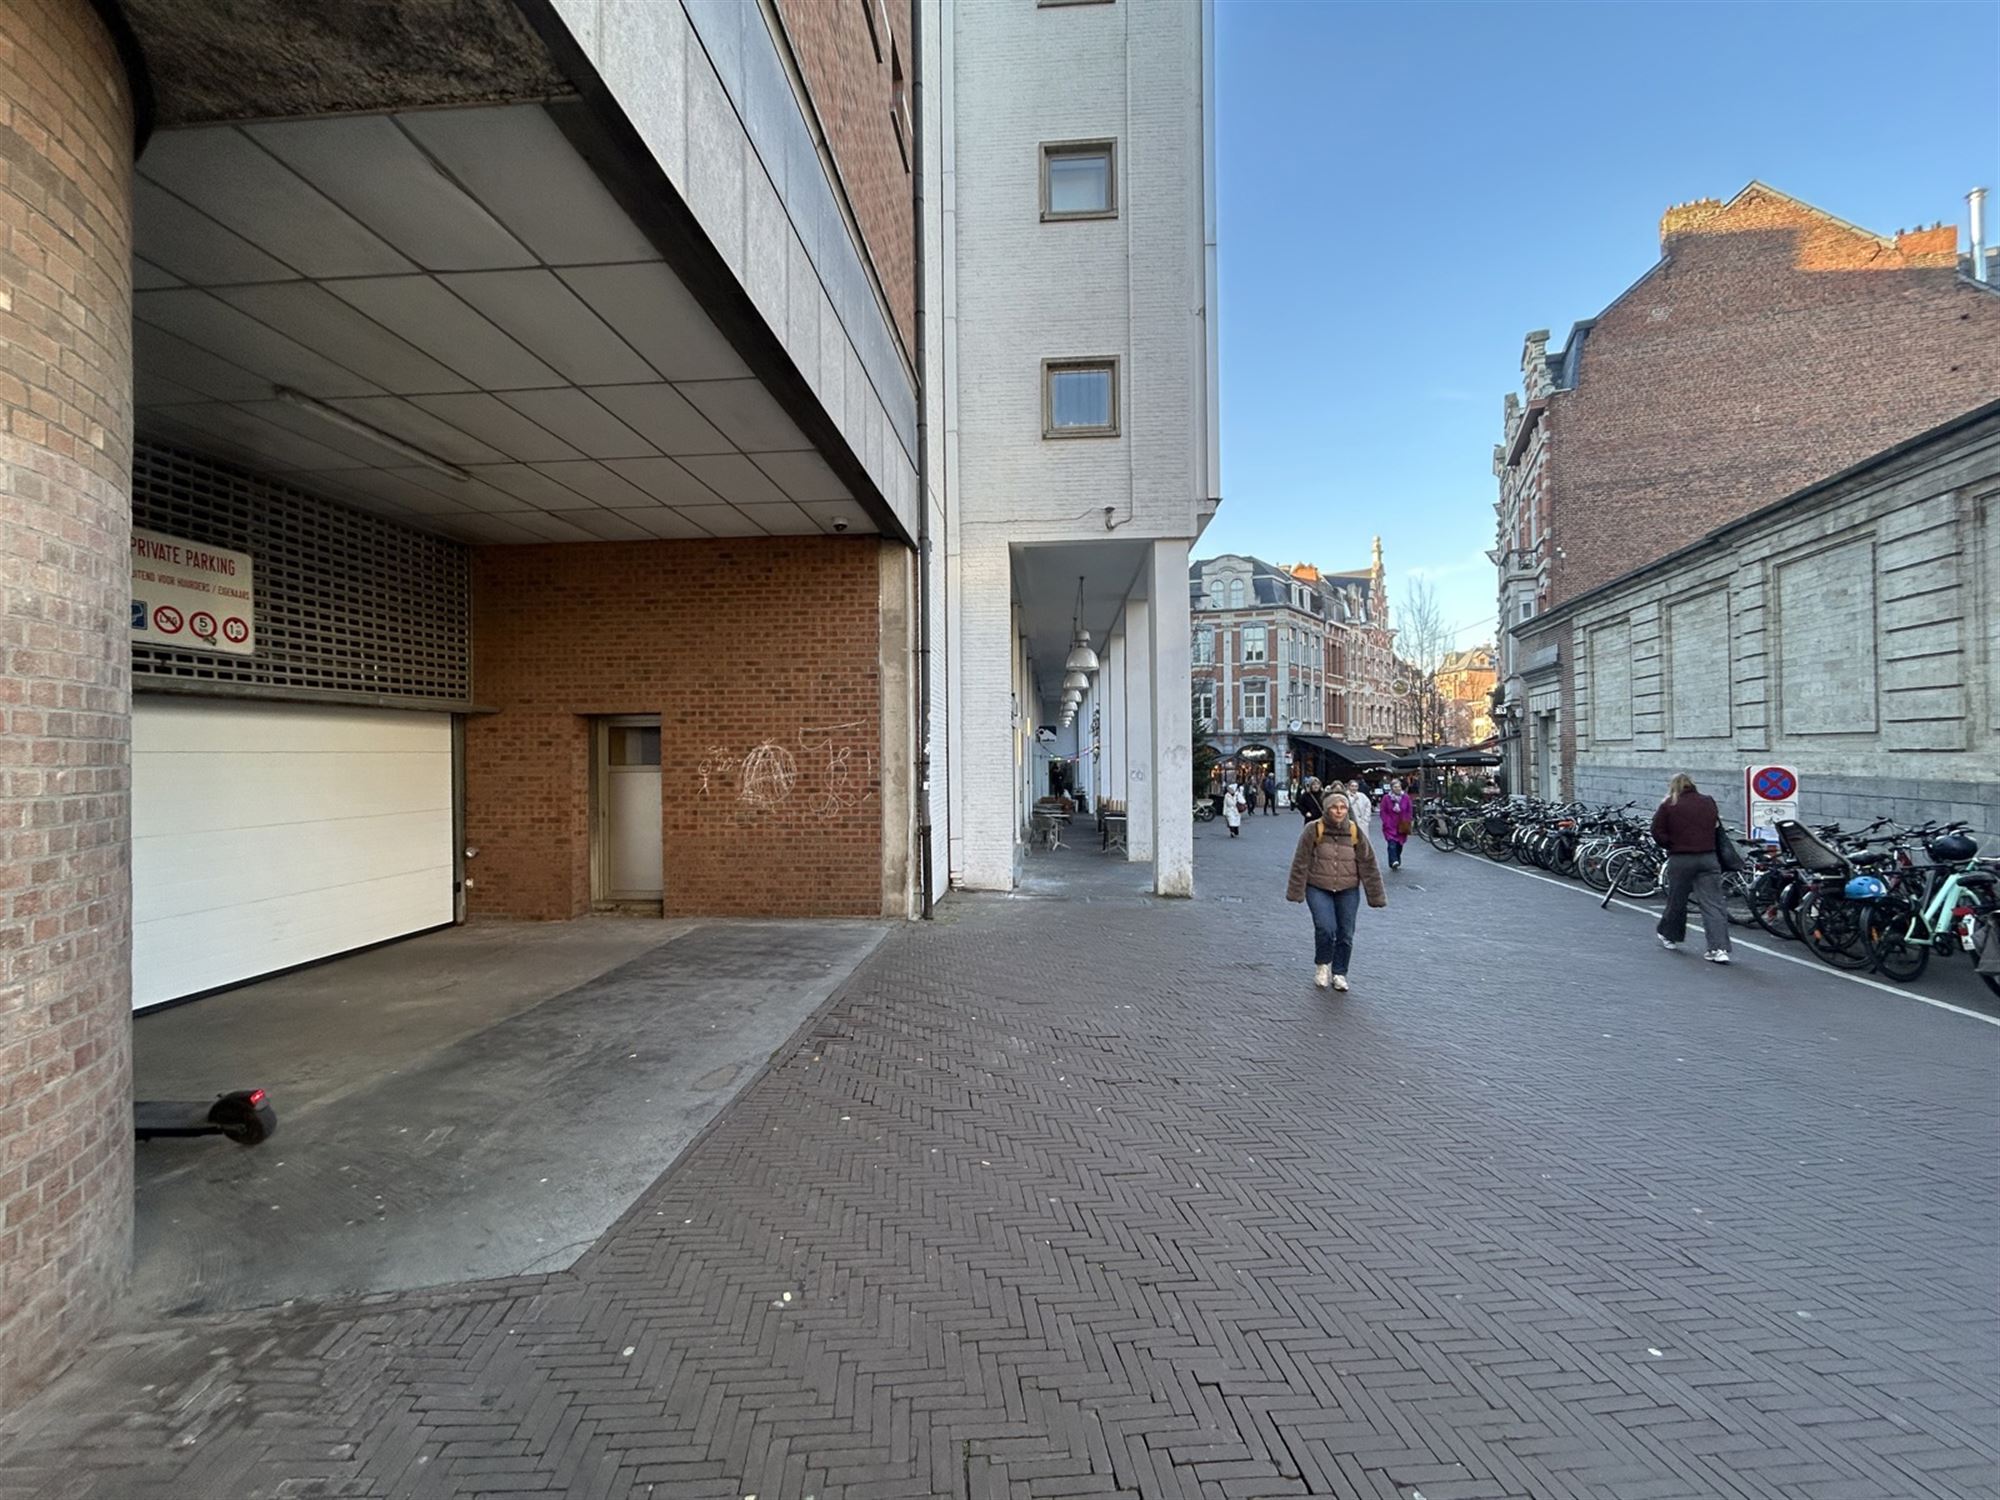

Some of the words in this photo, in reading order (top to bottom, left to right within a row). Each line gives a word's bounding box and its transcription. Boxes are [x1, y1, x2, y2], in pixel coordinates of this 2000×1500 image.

[131, 536, 181, 565] PRIVATE
[185, 549, 235, 576] PARKING
[199, 617, 208, 628] 5
